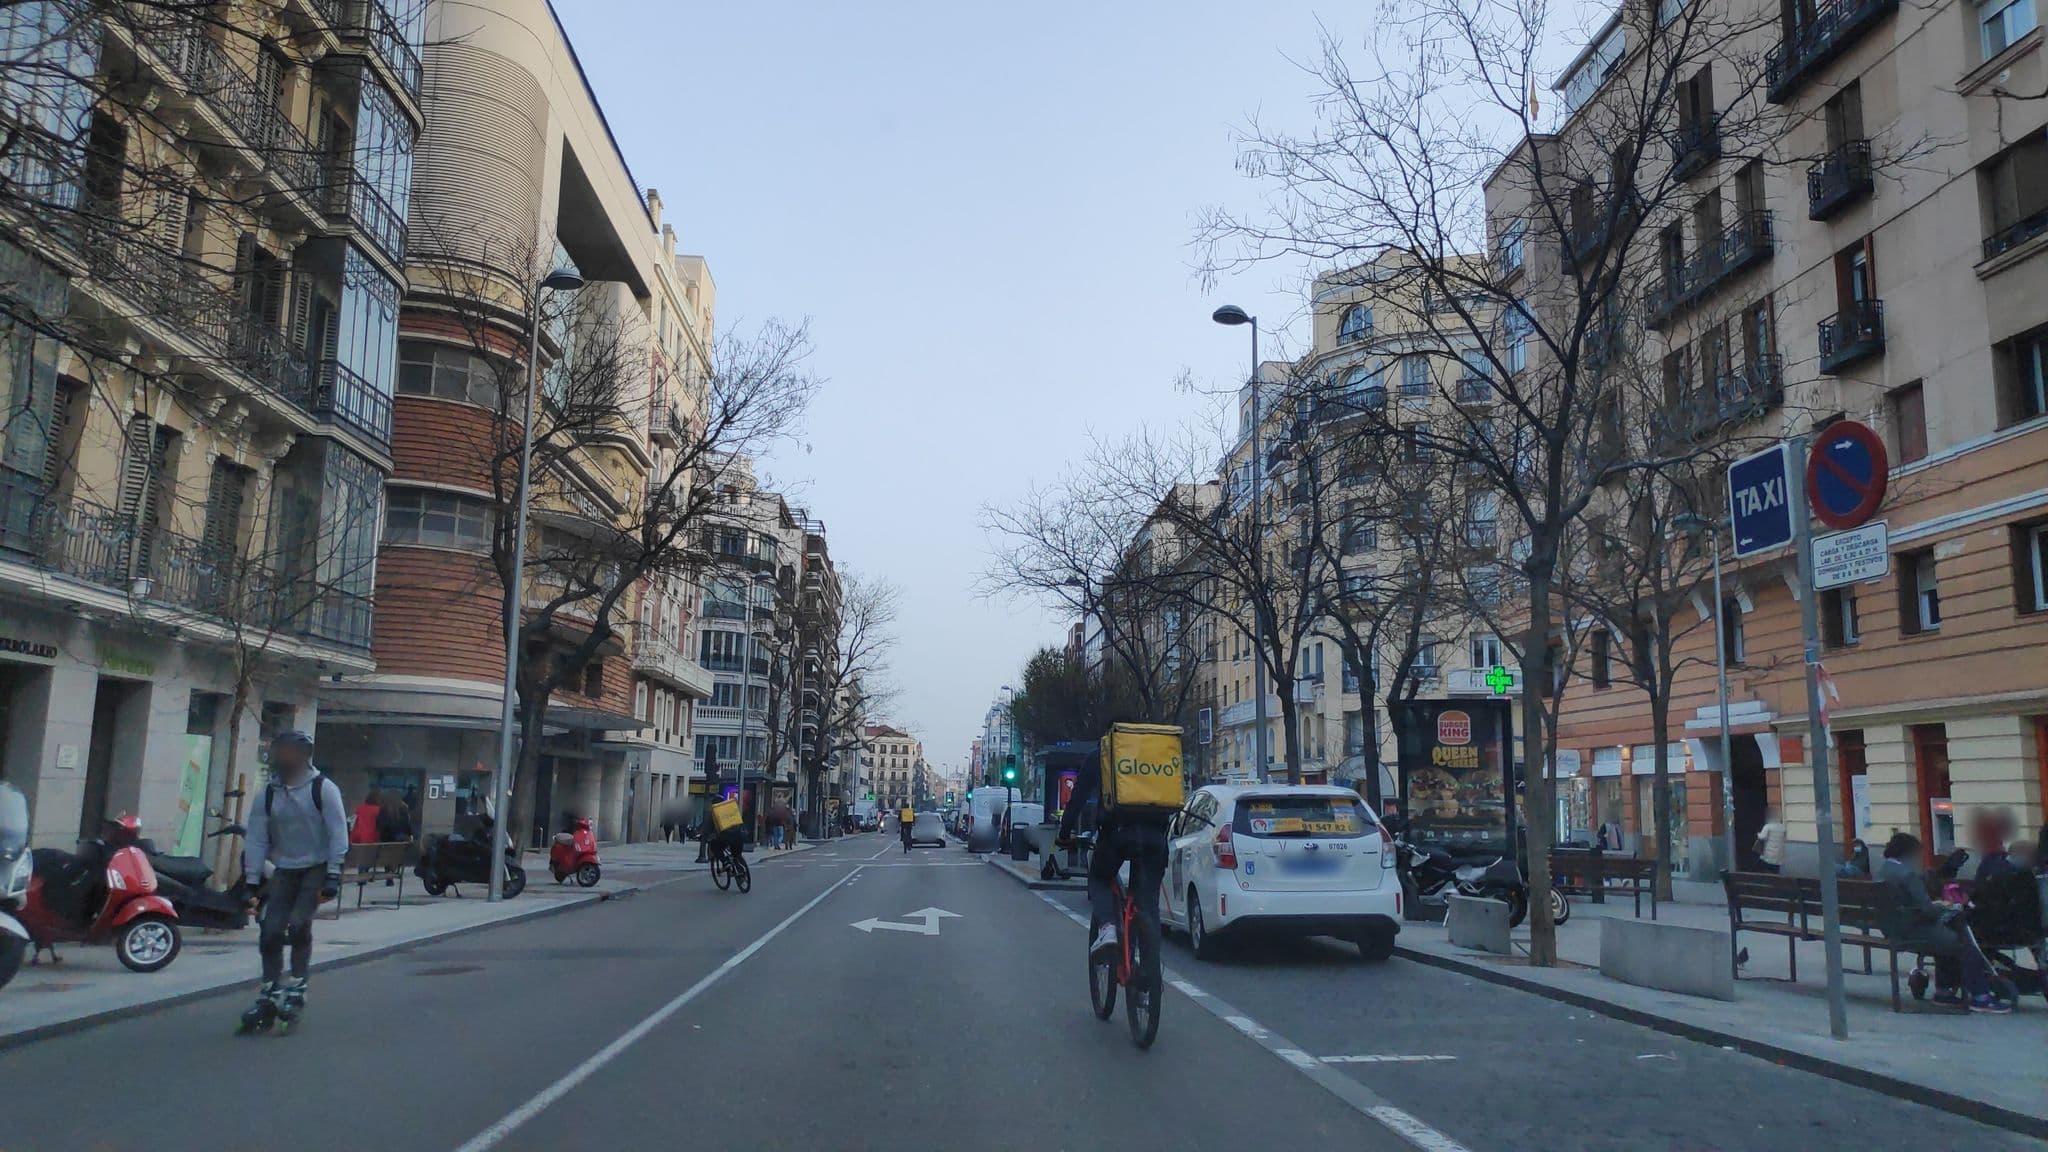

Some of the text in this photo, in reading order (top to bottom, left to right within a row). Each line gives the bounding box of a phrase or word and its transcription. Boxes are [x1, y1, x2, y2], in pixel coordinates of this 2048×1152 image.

[1735, 476, 1784, 517] TAXI
[1820, 547, 1839, 557] CARGA
[1847, 538, 1878, 550] DESCARGA
[1835, 534, 1861, 545] EXCEPTO
[1818, 563, 1848, 576] DOMINGOS
[1855, 556, 1883, 567] FESTIVOS
[1440, 721, 1469, 729] BURGER
[1440, 728, 1469, 738] KING
[1432, 746, 1478, 764] QUEEN
[1117, 757, 1174, 777] Glovo
[1316, 823, 1332, 833] 547
